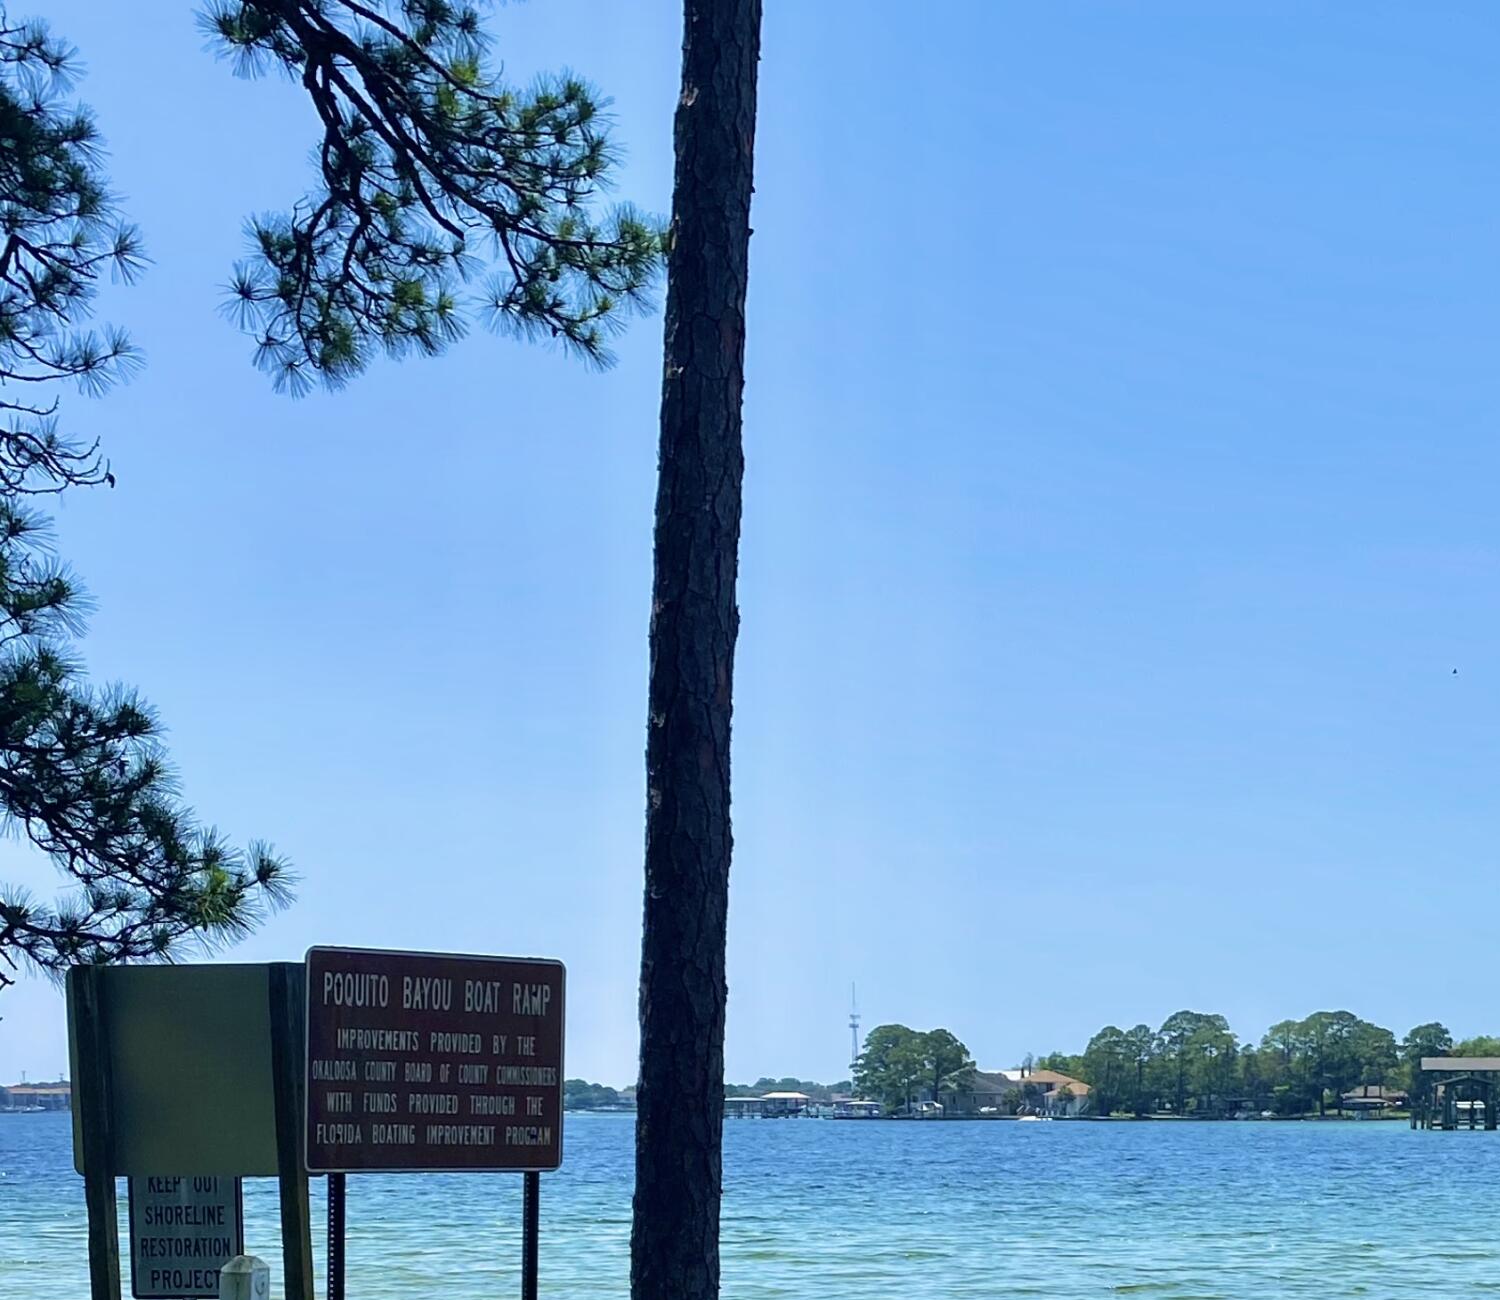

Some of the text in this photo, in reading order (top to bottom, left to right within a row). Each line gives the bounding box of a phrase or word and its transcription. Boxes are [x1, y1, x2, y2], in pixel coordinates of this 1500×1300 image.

[324, 972, 550, 1017] POQUITO BAYOU BOAT RAMP
[338, 1028, 536, 1056] IMPROVEMENTS PROVIDED BY THE
[312, 1060, 556, 1086] OKALOOSA COUNTY BOARD OF COUNTY COMMISSIONERS
[326, 1092, 544, 1116] WITH FUNDS PROVIDED THROUGH THE
[317, 1123, 551, 1146] FLORIDA BOATING IMPROVEMENT PROGRAM
[148, 1176, 181, 1193] KEEP
[145, 1205, 225, 1225] SHORELINE
[141, 1237, 231, 1257] RESTORATION
[151, 1269, 221, 1290] PROJECT
